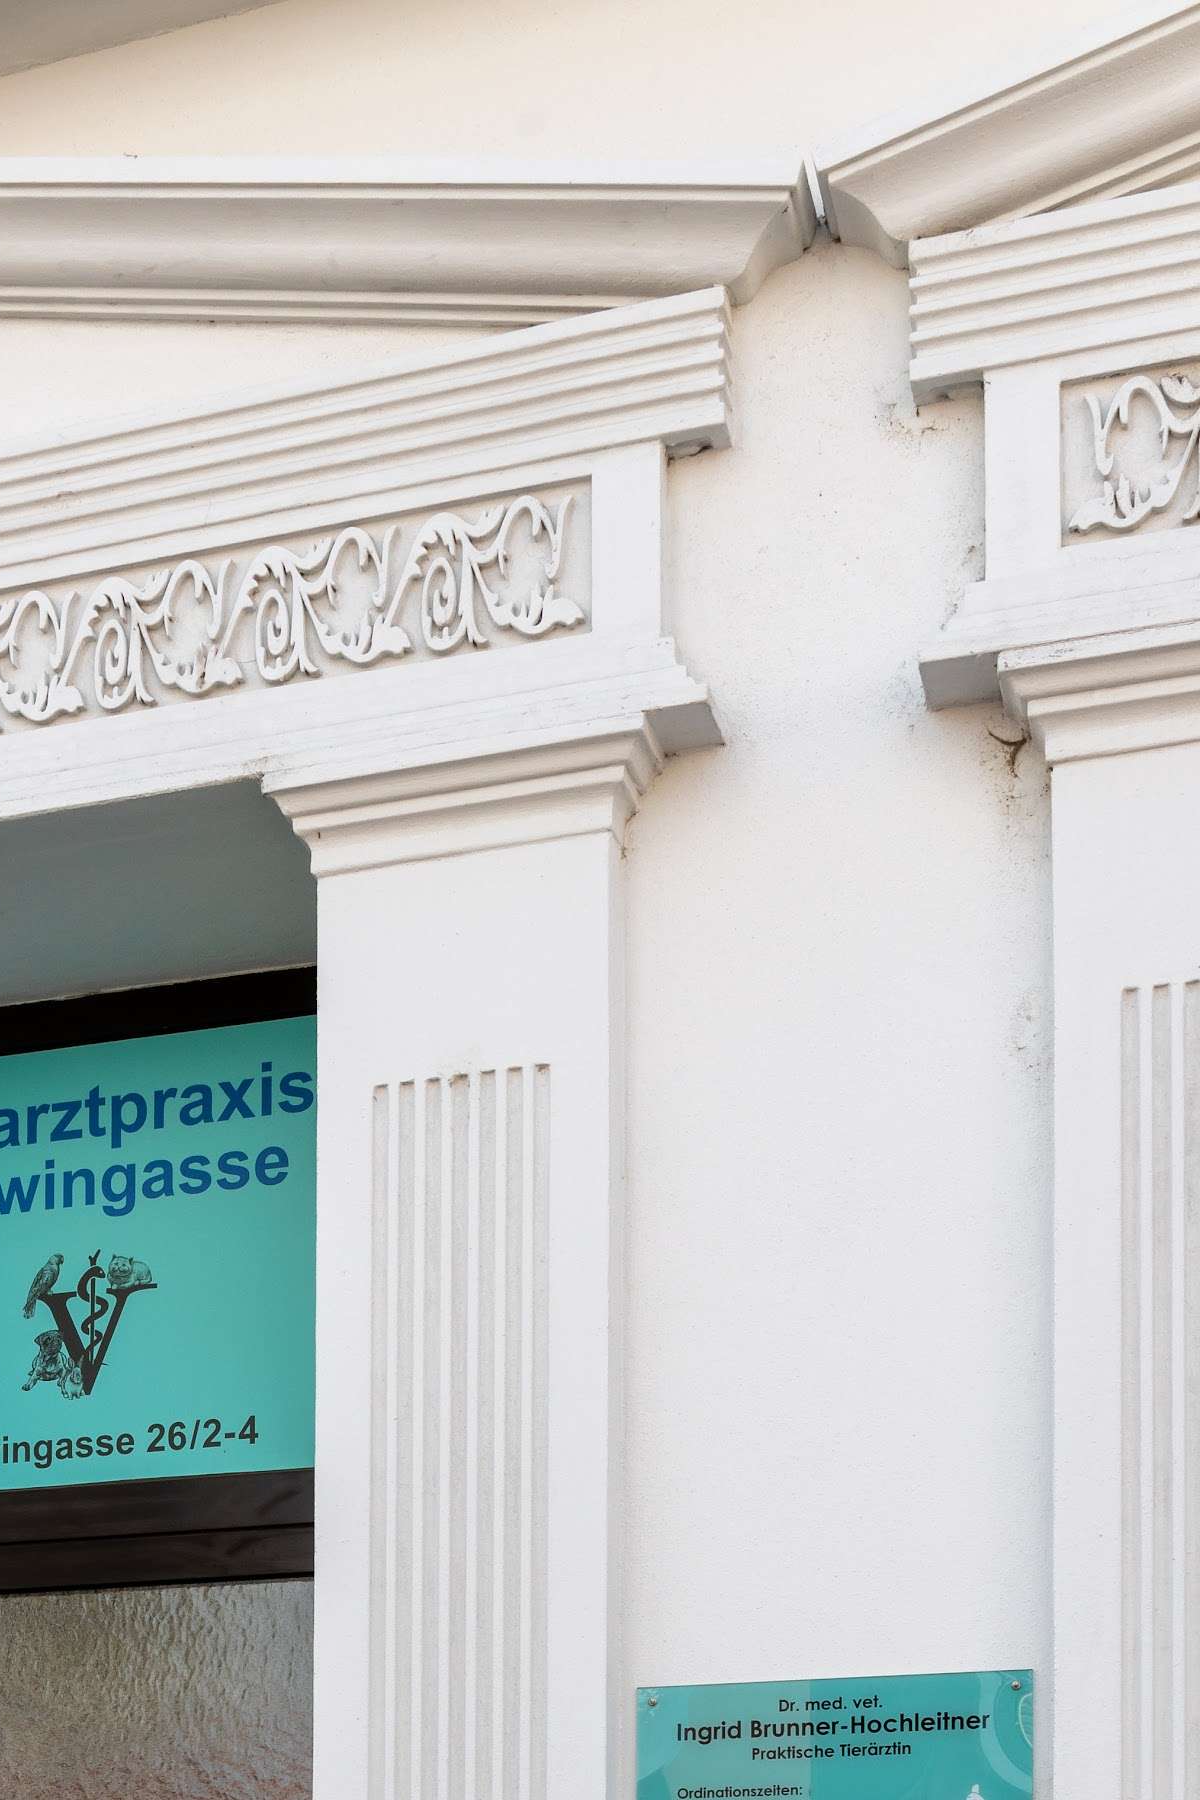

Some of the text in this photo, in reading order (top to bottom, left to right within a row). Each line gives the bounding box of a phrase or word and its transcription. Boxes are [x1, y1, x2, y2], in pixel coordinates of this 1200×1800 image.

[146, 1415, 260, 1455] 26/2-4
[778, 1695, 883, 1713] Dr. med. vet.
[676, 1712, 990, 1745] Ingrid Brunner-Hochleitner
[751, 1741, 912, 1761] Praktische Tierärztin
[677, 1785, 803, 1799] Ordinationszeiten:
